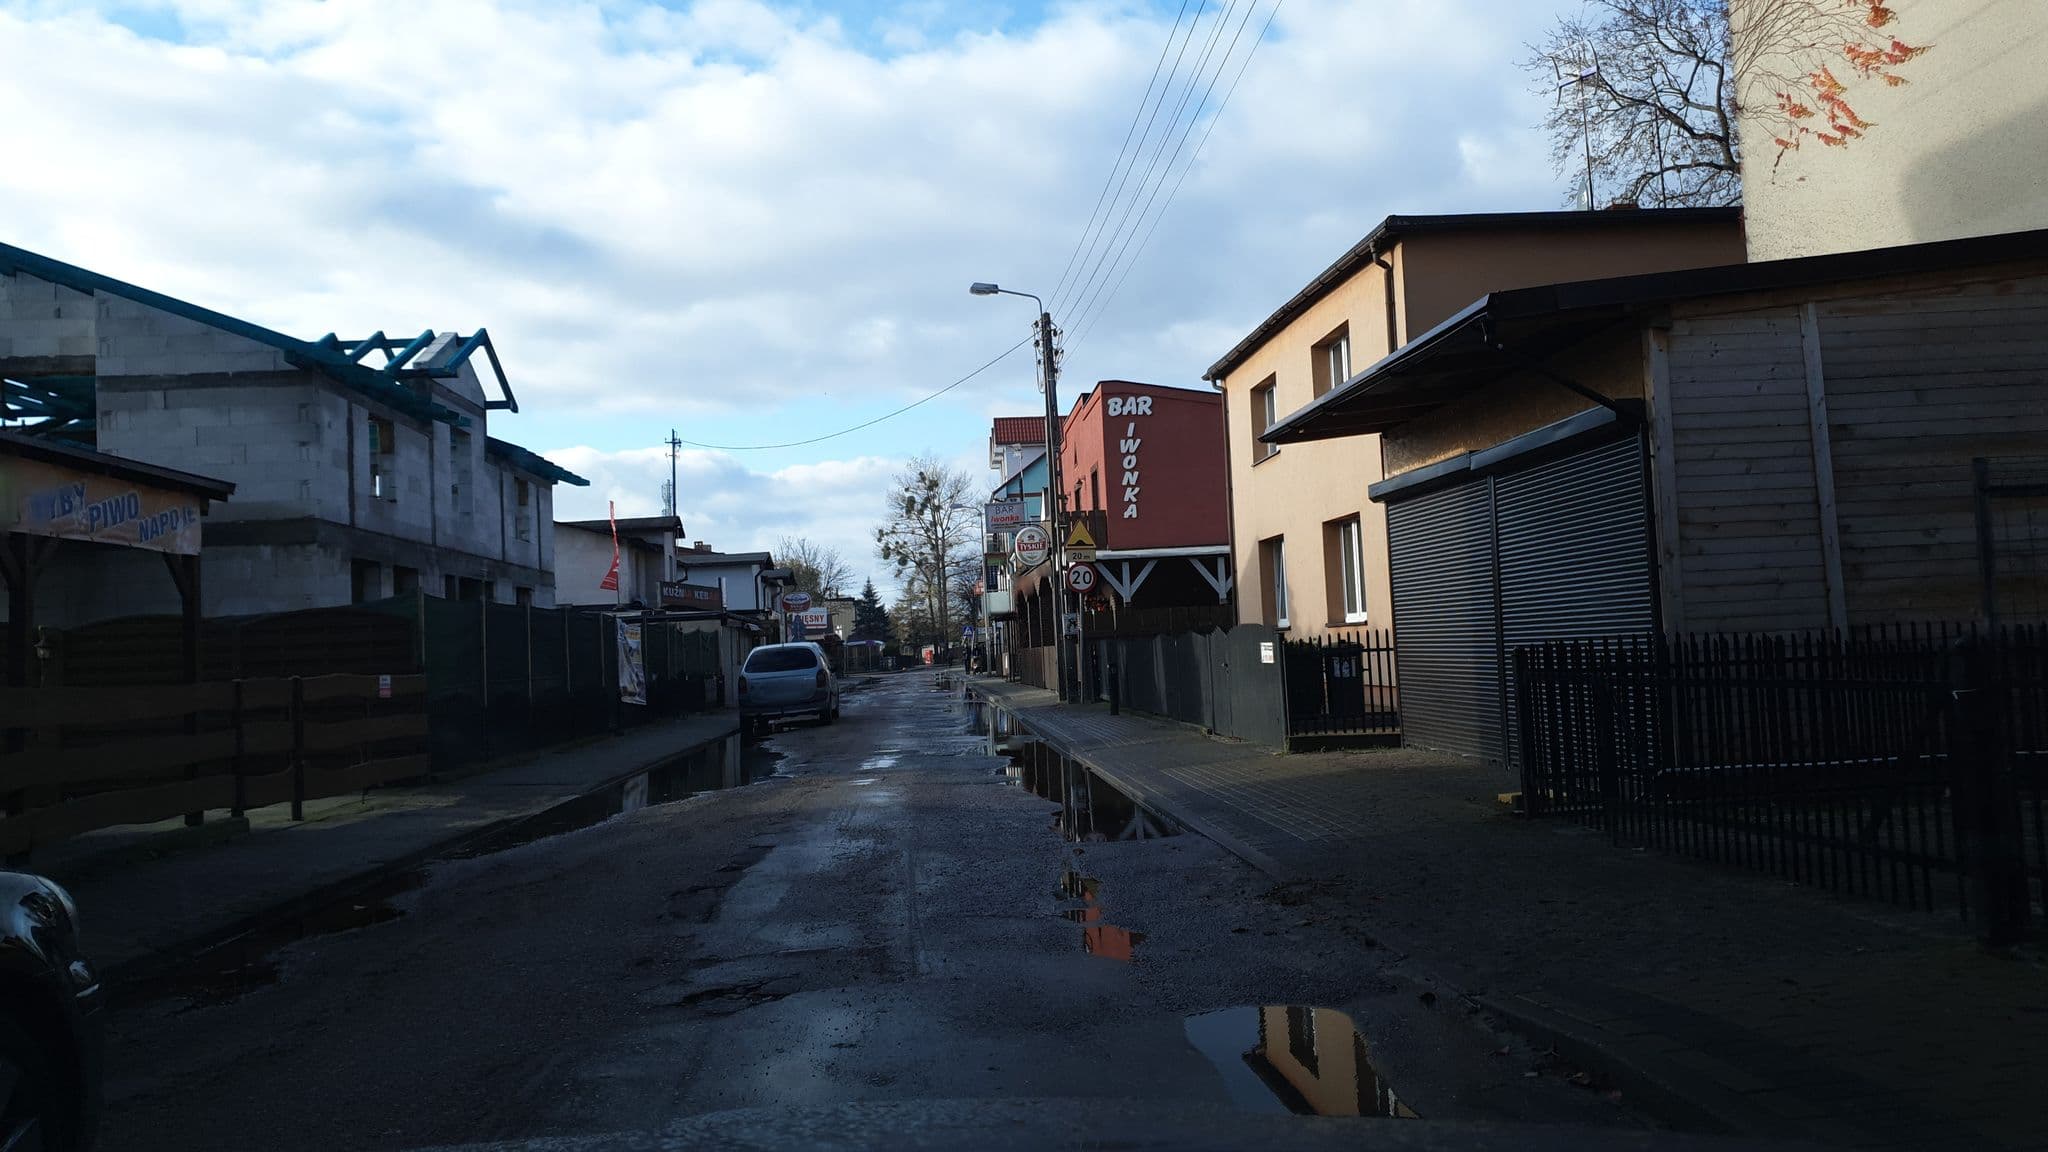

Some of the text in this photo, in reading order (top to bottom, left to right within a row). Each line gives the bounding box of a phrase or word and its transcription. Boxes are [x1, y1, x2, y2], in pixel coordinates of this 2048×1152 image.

[1107, 396, 1153, 417] BAR
[1119, 422, 1142, 519] IWONKA
[87, 492, 140, 533] PIWO
[995, 505, 1014, 515] BAR
[1019, 542, 1044, 551] TYSKIE
[1072, 552, 1082, 560] 20
[1072, 571, 1092, 585] 20
